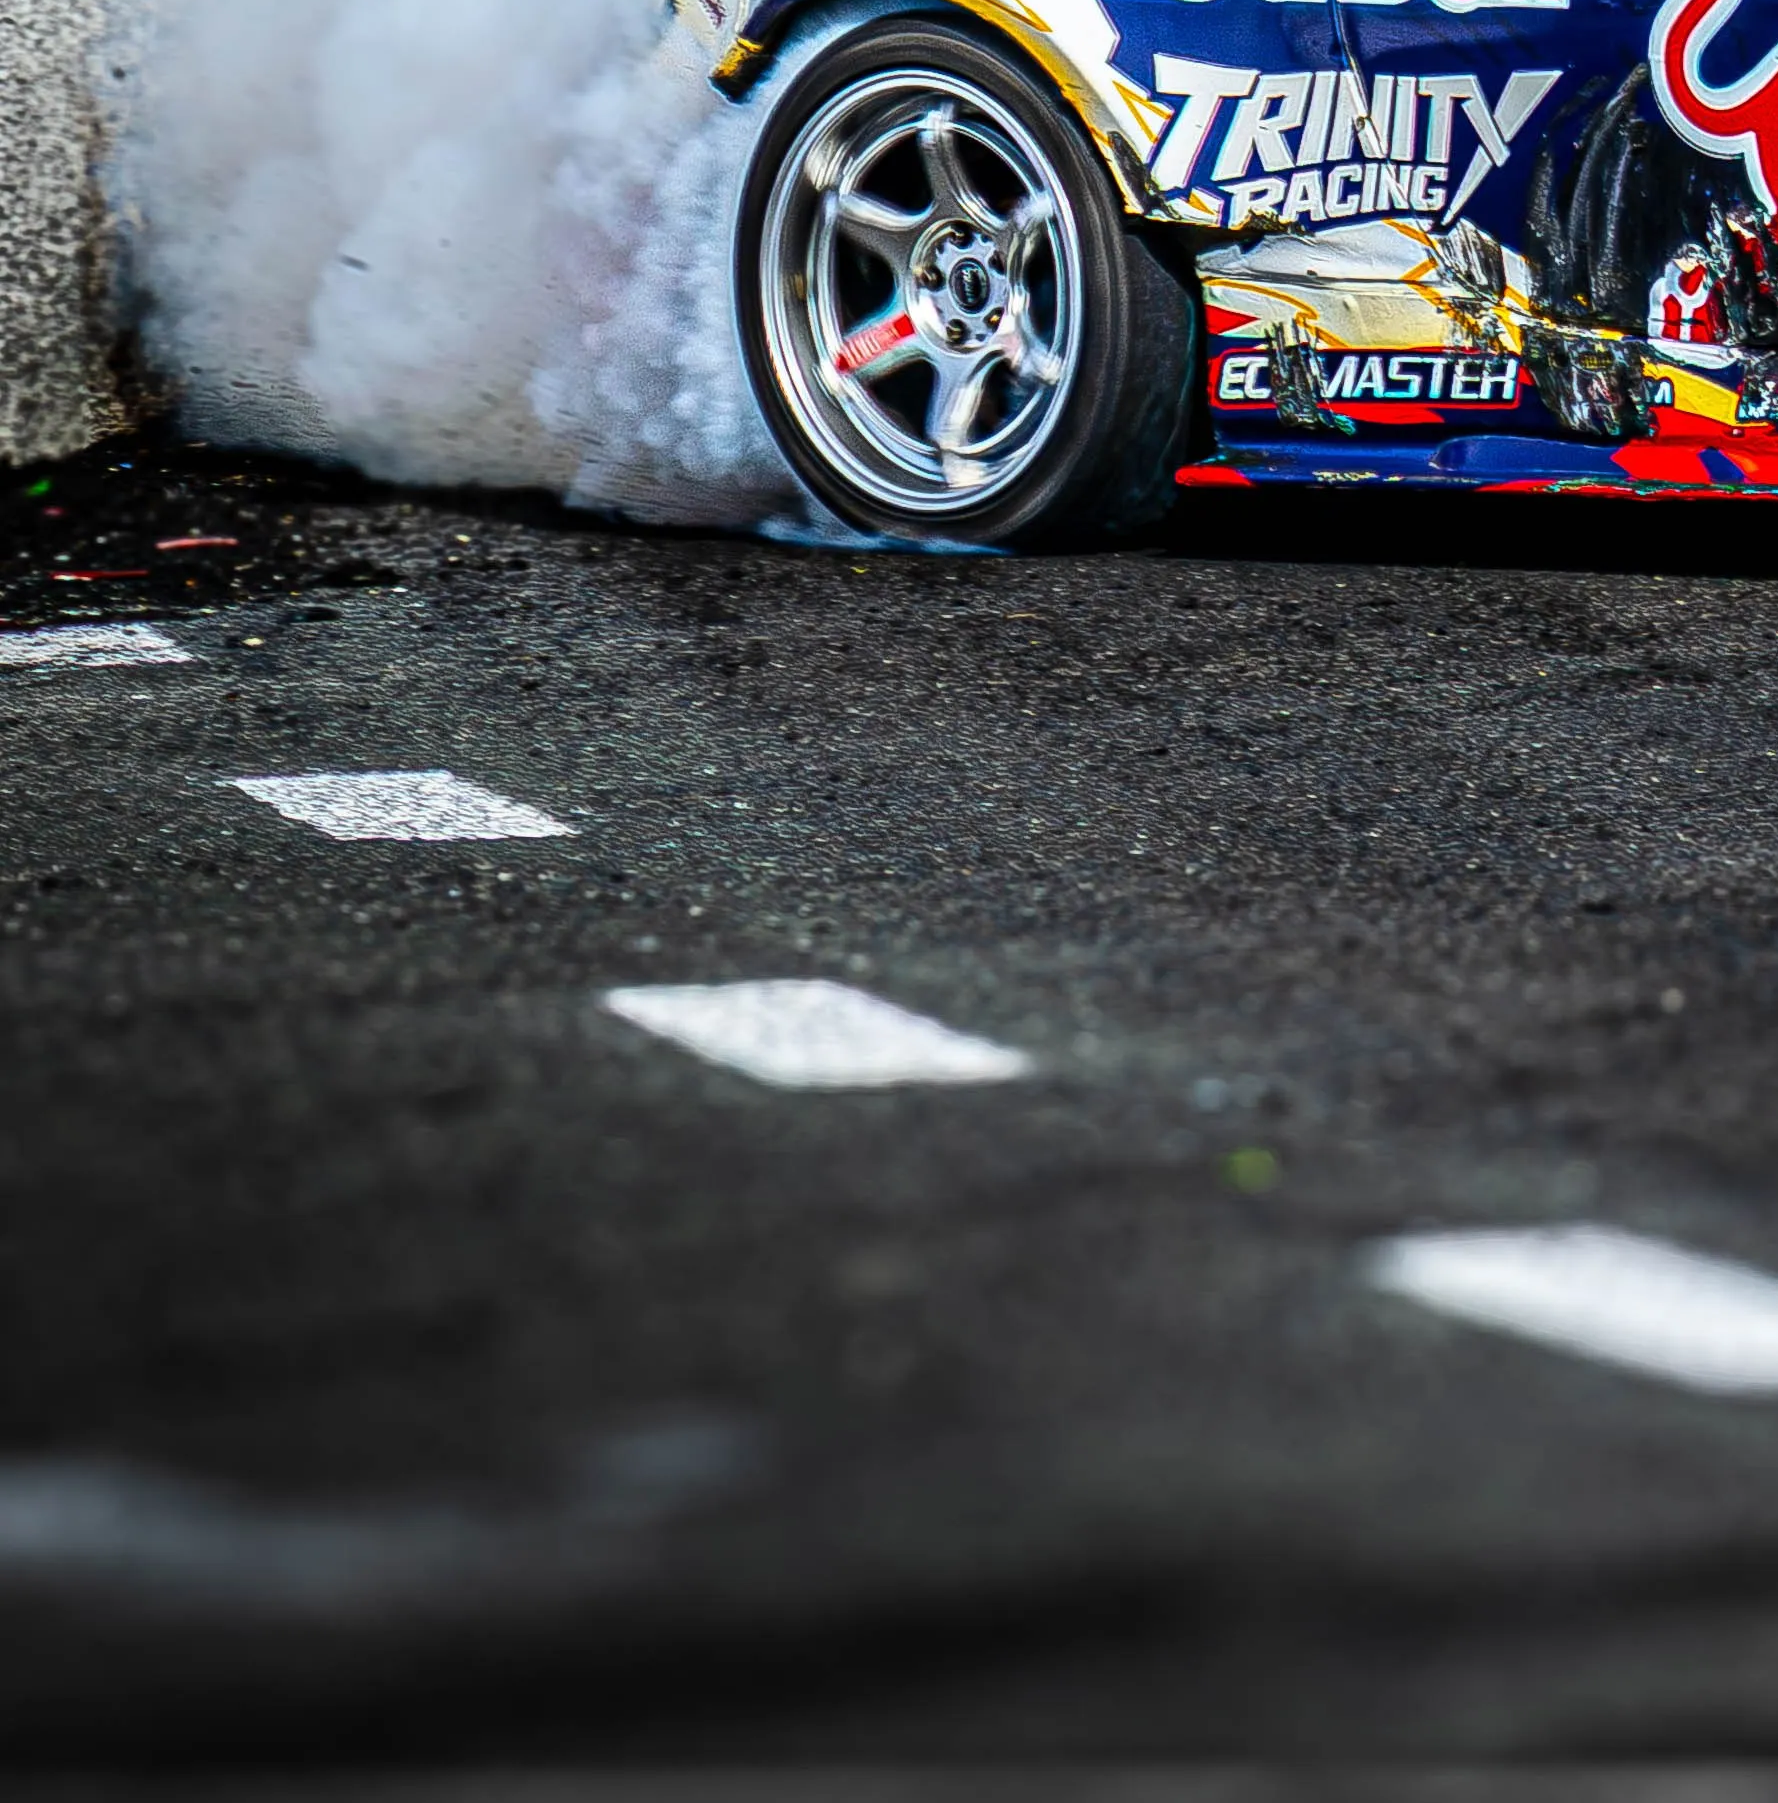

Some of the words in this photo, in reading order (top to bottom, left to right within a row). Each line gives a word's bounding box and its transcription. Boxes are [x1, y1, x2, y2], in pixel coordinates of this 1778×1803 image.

[1151, 54, 1563, 225] TRINITY
[1217, 163, 1448, 230] RACING
[1220, 355, 1518, 400] ECMASTER
